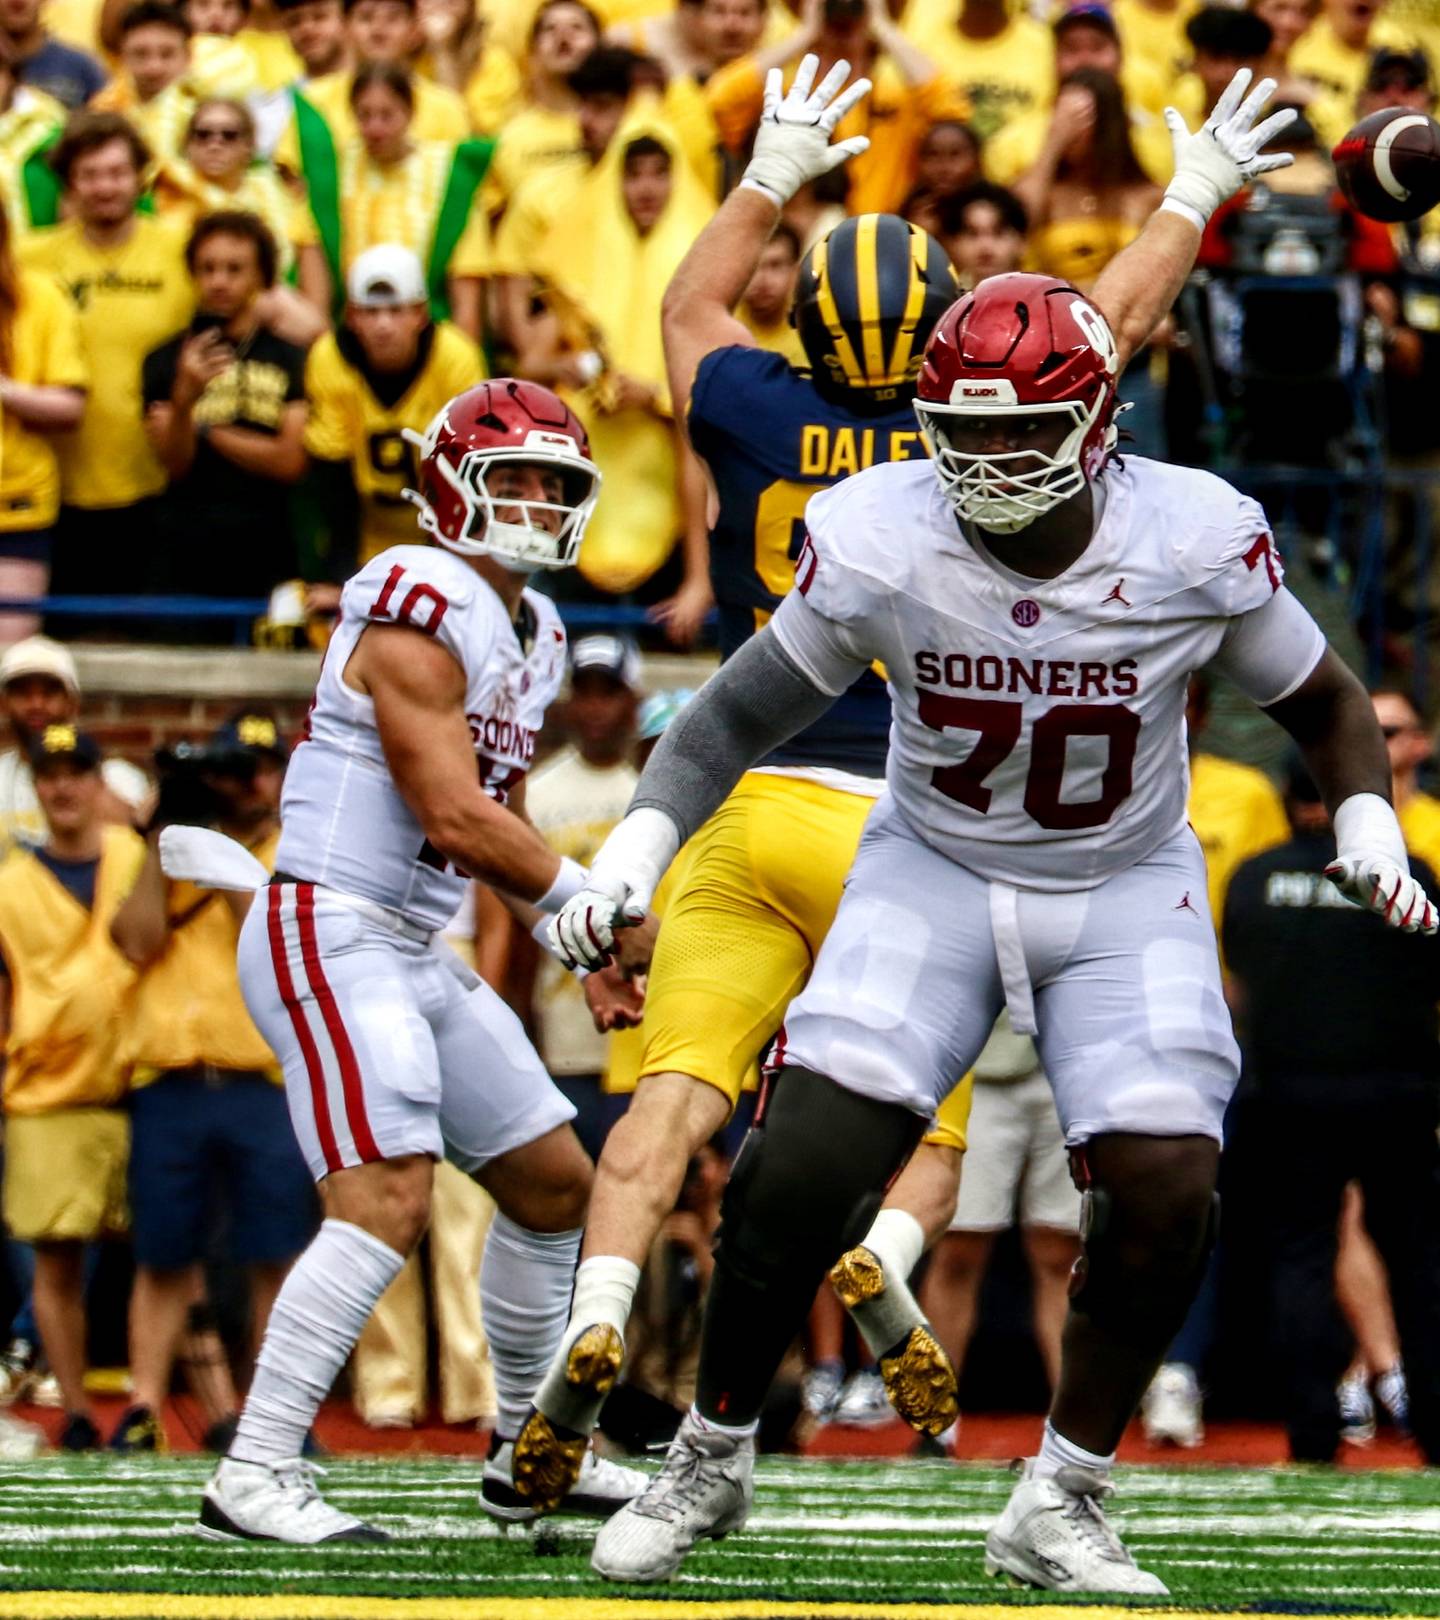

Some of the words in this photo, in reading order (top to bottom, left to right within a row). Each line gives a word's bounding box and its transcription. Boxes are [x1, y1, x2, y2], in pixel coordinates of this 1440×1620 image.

[1241, 532, 1283, 594] 7
[369, 564, 449, 636] 10
[1013, 602, 1039, 625] SEC
[914, 651, 1139, 698] SOONERS
[466, 714, 537, 764] SOONE
[914, 687, 1142, 830] 70
